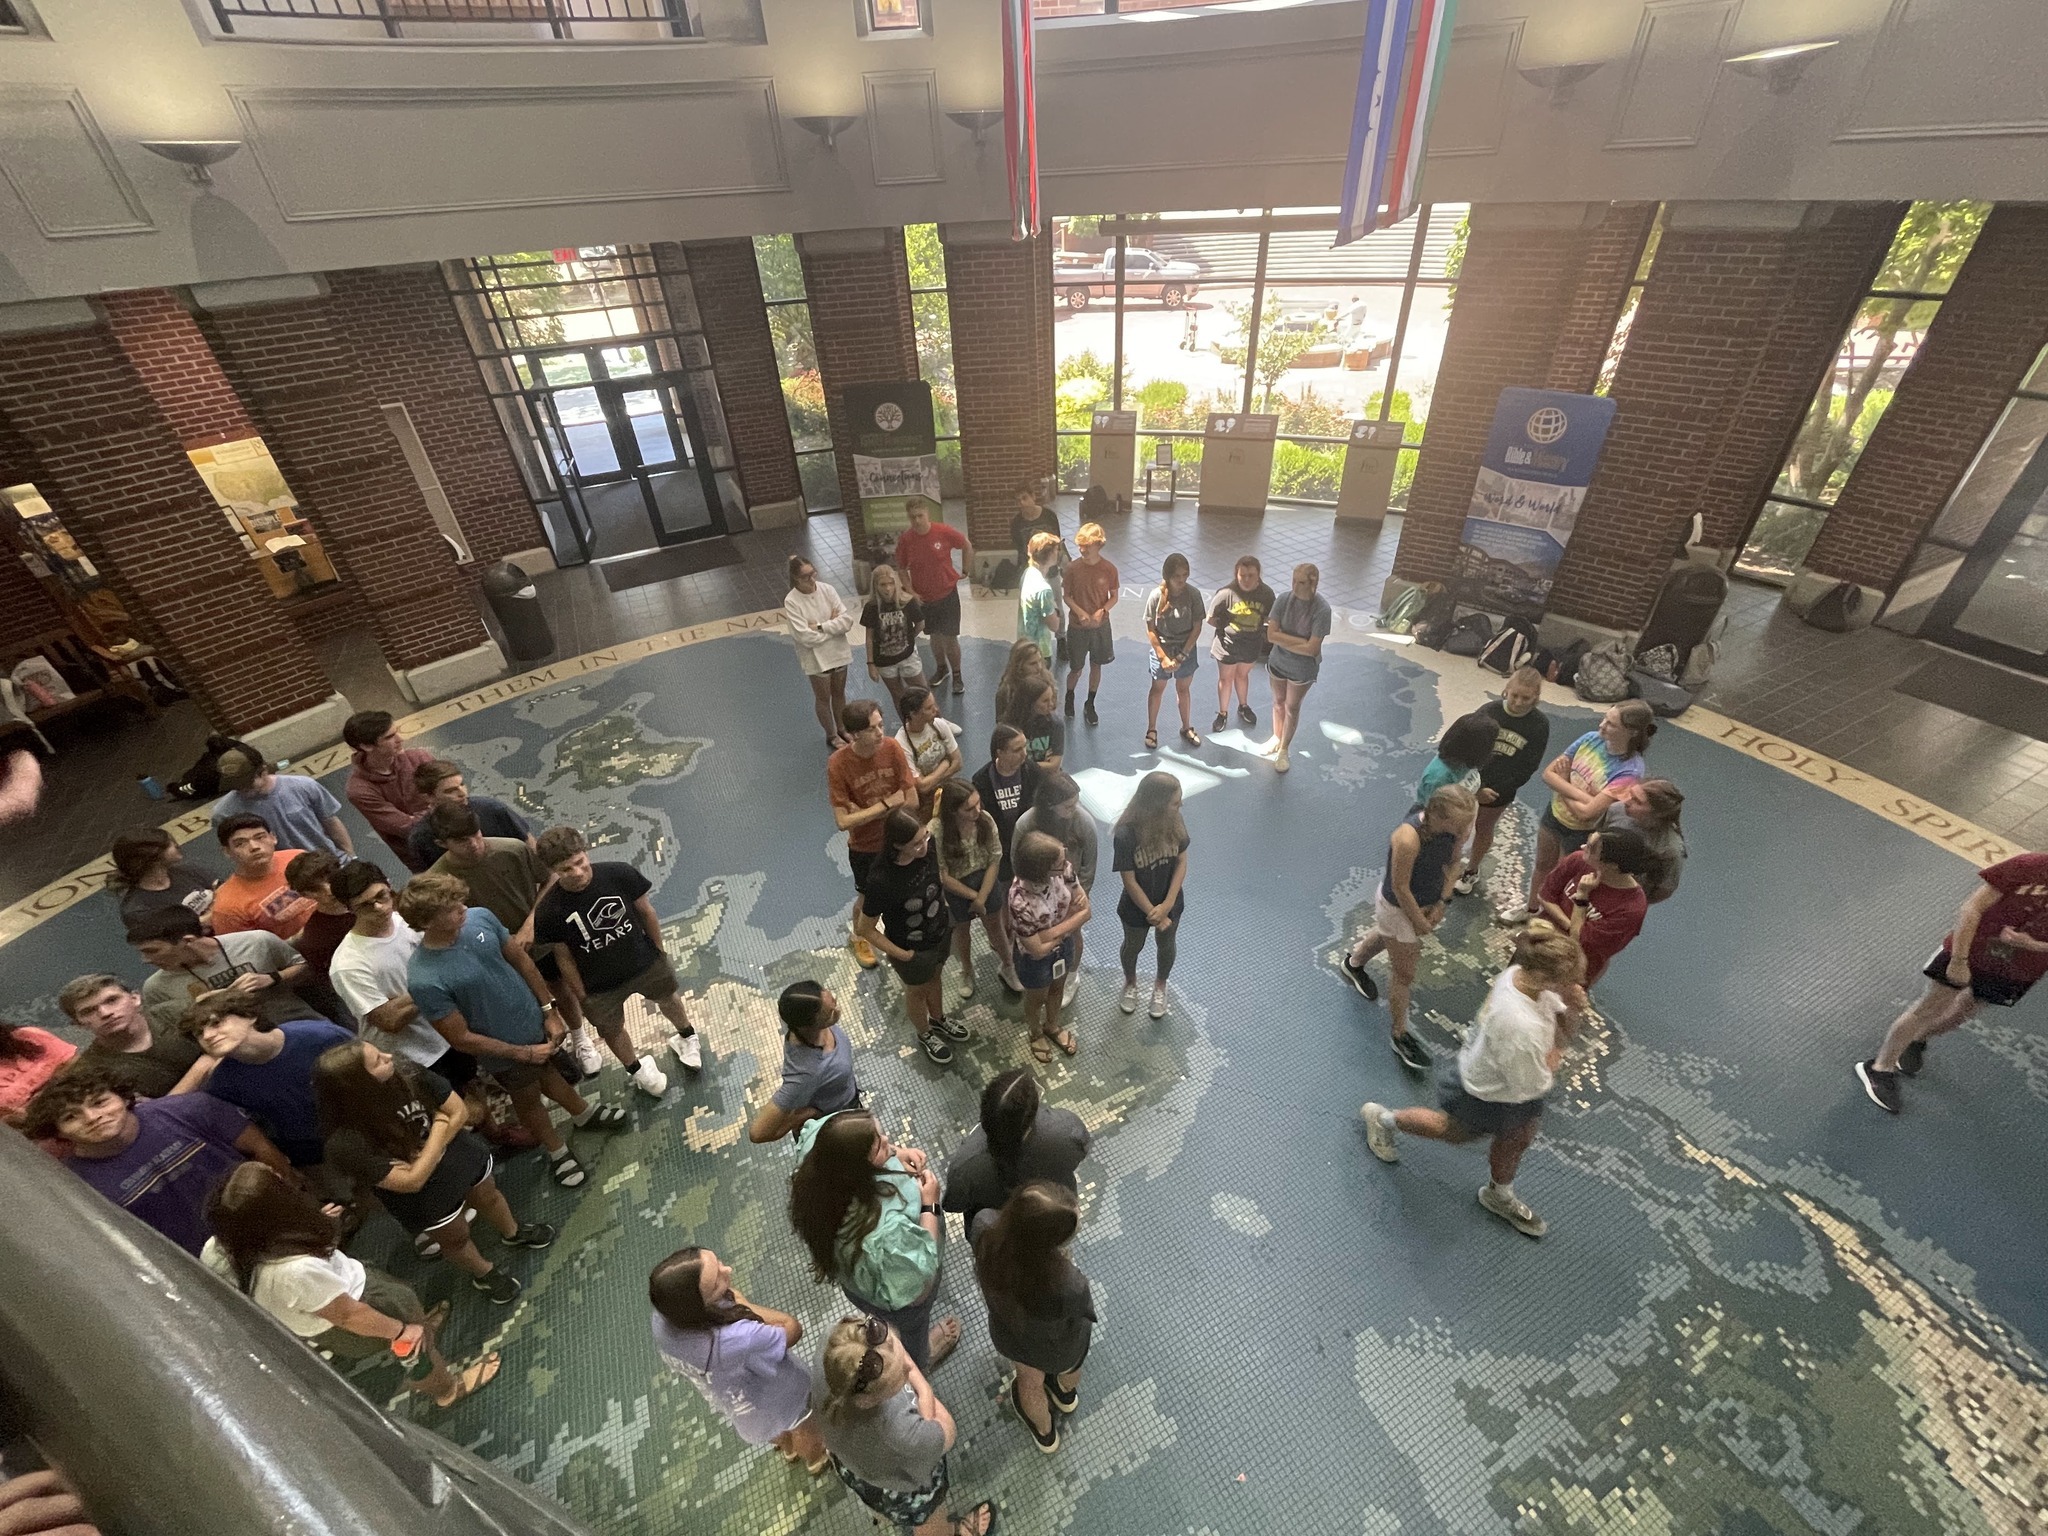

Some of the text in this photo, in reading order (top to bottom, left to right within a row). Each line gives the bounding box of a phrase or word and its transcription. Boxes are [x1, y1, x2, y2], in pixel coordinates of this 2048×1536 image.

[1514, 494, 1527, 509] &
[1528, 498, 1561, 515] World
[446, 670, 558, 712] THEM
[579, 651, 619, 672] IN
[1719, 717, 2009, 864] HOLY SPIR
[580, 919, 633, 954] YEARS
